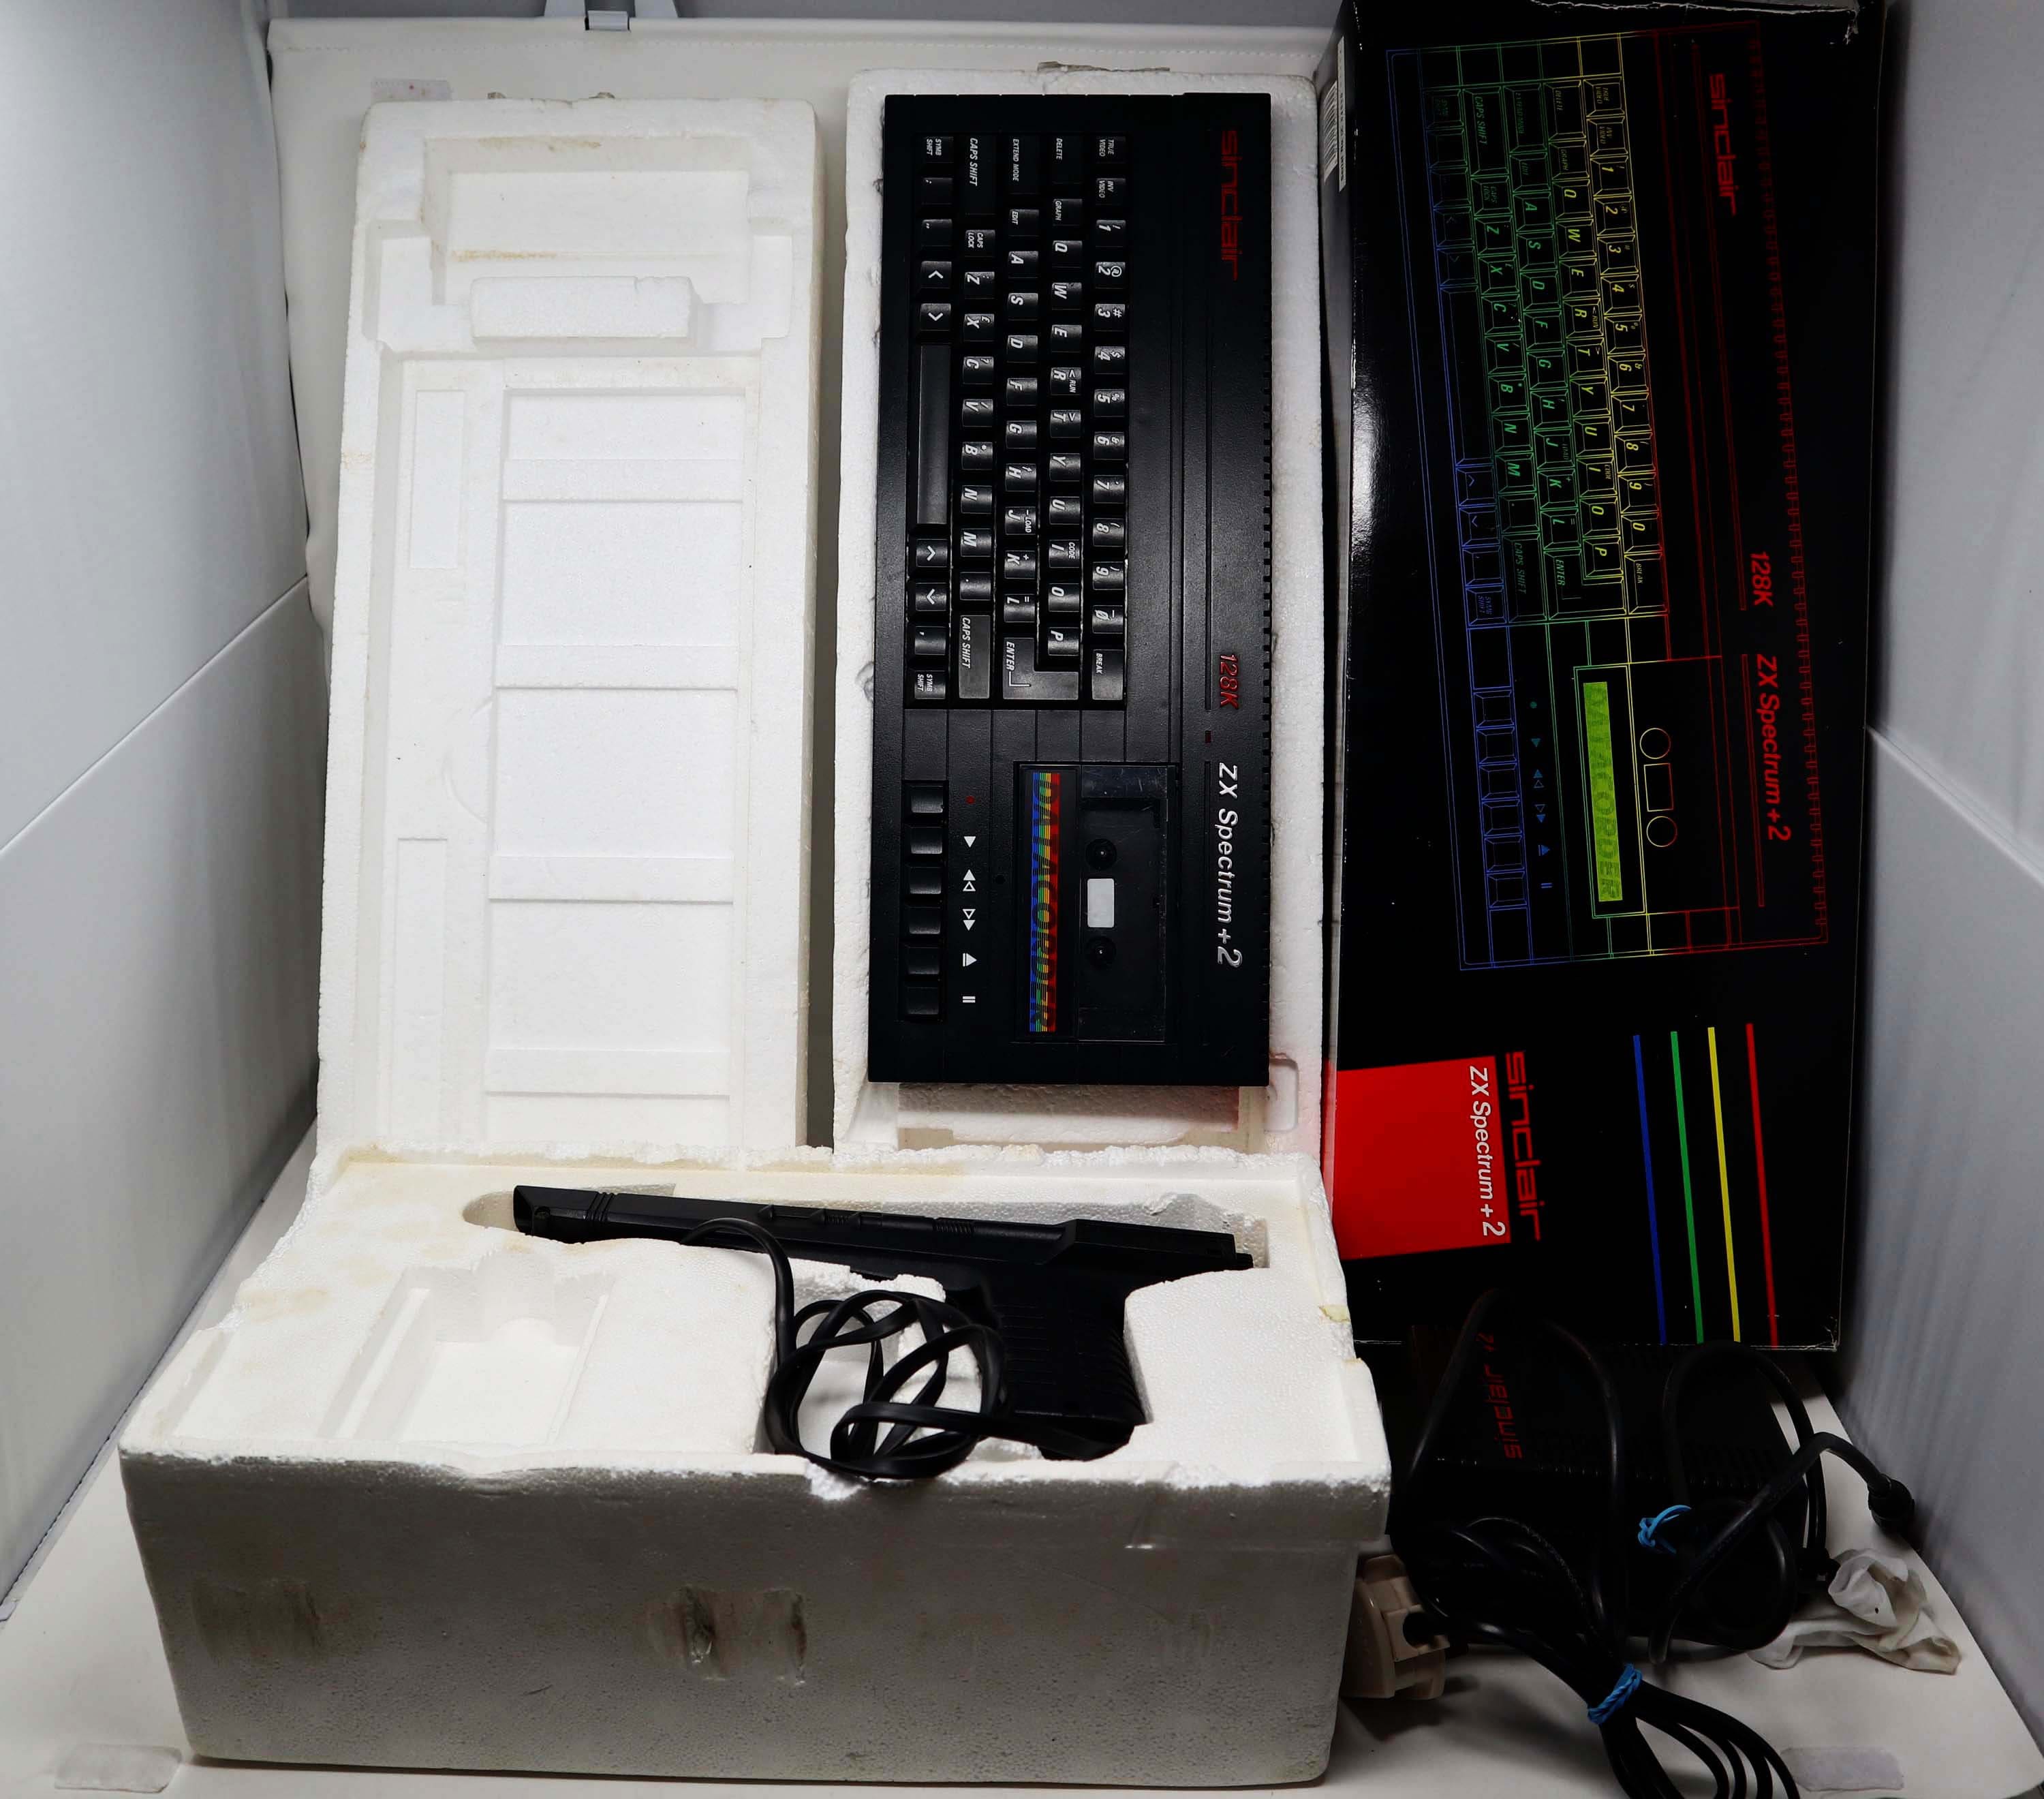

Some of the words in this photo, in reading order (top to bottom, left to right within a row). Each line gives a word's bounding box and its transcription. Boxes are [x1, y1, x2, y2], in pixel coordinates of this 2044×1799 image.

[1474, 97, 1484, 118] CAPS
[1477, 121, 1487, 145] SHIFT
[1708, 72, 1741, 217] sinclair
[1560, 149, 1568, 170] GRAPH
[970, 161, 978, 187] SHIFT
[1564, 189, 1577, 198] Q
[1221, 130, 1243, 282] sinclair
[1525, 202, 1537, 211] A
[1605, 206, 1618, 215] 2
[1487, 225, 1499, 235] Z
[1568, 229, 1581, 243] W
[1055, 243, 1068, 252] Q
[1528, 240, 1541, 250] S
[1609, 245, 1622, 253] 3
[1011, 254, 1023, 264] A
[1490, 266, 1503, 275] X
[1571, 268, 1584, 277] E
[967, 275, 980, 285] Z
[1532, 281, 1545, 290] D
[1612, 284, 1624, 293] 4
[1055, 285, 1067, 299] W
[1010, 296, 1023, 305] S
[1098, 308, 1111, 317] 3
[1493, 303, 1506, 312] C
[1575, 309, 1587, 318] R
[967, 317, 980, 328] X
[1535, 320, 1548, 330] F
[1055, 327, 1067, 337] E
[1615, 324, 1628, 332] 5
[1010, 338, 1023, 348] D
[1497, 343, 1509, 352] V
[1098, 352, 1110, 361] 4
[966, 358, 978, 369] C
[1538, 360, 1551, 368] G
[1619, 364, 1632, 372] 6
[1054, 371, 1066, 380] R
[1010, 381, 1022, 391] F
[1500, 384, 1513, 393] B
[1581, 386, 1594, 395] Y
[1098, 395, 1109, 403] 5
[1543, 399, 1555, 409] H
[966, 401, 978, 412] V
[1053, 413, 1066, 422] T
[1009, 423, 1021, 433] G
[1504, 423, 1517, 433] N
[1585, 427, 1597, 436] U
[1098, 436, 1109, 446] 6
[1546, 437, 1558, 447] J
[965, 444, 977, 455] B
[1626, 442, 1639, 451] 8
[1053, 456, 1066, 465] Y
[1008, 466, 1021, 478] H
[1507, 463, 1521, 477] M
[1097, 480, 1109, 489] 7
[1549, 479, 1562, 488] K
[1629, 482, 1642, 490] 9
[965, 488, 977, 500] N
[1053, 499, 1064, 510] U
[1008, 510, 1020, 519] J
[1592, 506, 1604, 515] O
[1096, 523, 1109, 533] 8
[1632, 522, 1645, 532] 0
[963, 532, 976, 547] M
[1515, 543, 1524, 565] CAPS
[1594, 547, 1607, 556] P
[1007, 553, 1019, 565] K
[1096, 567, 1109, 576] 9
[1555, 559, 1565, 586] ENTER
[1517, 568, 1527, 594] SHIFT
[1750, 551, 1774, 607] 128K
[1051, 587, 1064, 597] O
[962, 617, 970, 641] CAPS
[1051, 630, 1064, 641] P
[962, 642, 970, 668] SHIFT
[1006, 642, 1015, 671] ENTER
[1754, 654, 1780, 688] ZX
[1220, 654, 1239, 710] 128K
[1220, 763, 1238, 799] ZX
[1585, 683, 1622, 901] DATACORDER
[1470, 1066, 1489, 1096] ZX
[1470, 1101, 1493, 1199] Spectrum
[1504, 1051, 1547, 1242] sinclair
[1483, 1363, 1525, 1460] sinclair
